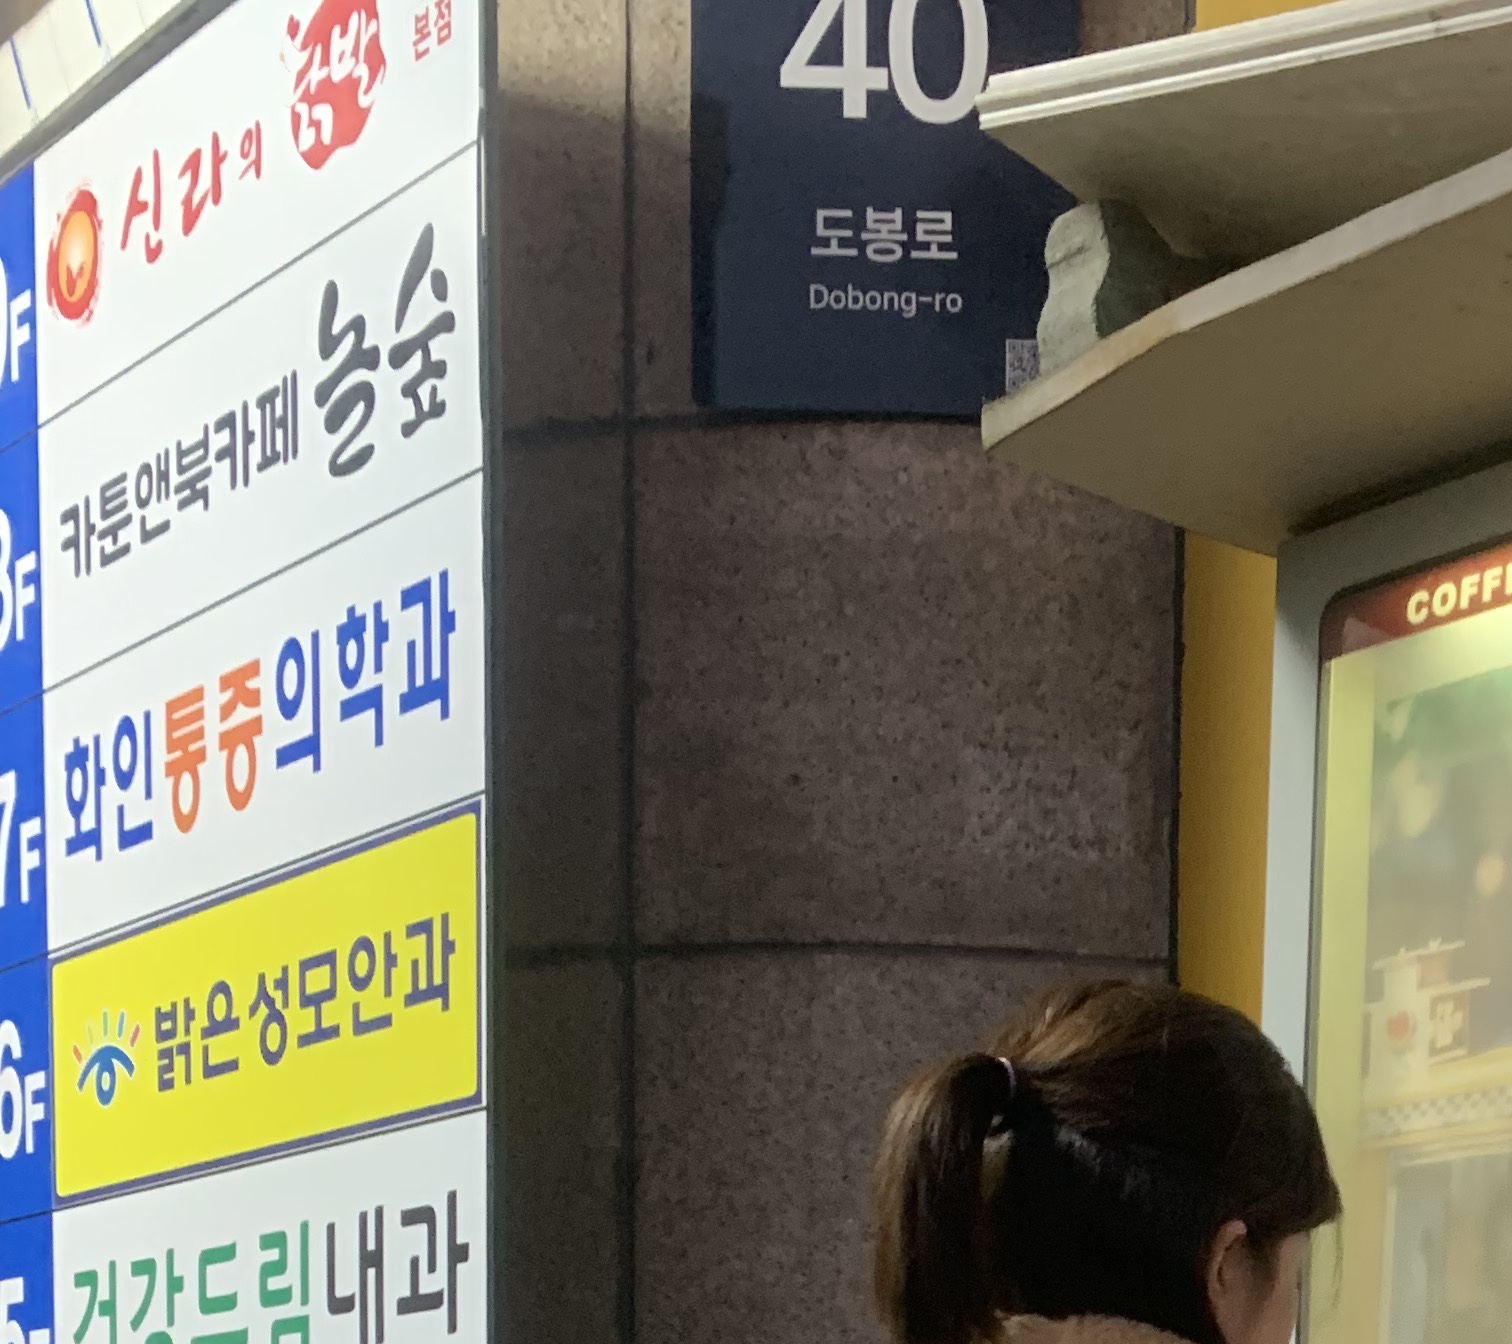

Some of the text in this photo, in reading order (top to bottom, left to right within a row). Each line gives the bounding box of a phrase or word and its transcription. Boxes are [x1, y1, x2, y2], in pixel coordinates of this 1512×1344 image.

[121, 120, 263, 264] 신라의
[412, 0, 452, 61] 본점
[780, 0, 989, 124] 40
[809, 283, 962, 318] Dobong-ro
[810, 206, 958, 263] 도봉로
[59, 222, 456, 578] 카툰앤북카페 놀숲
[64, 568, 456, 862] 화인통증의학과
[0, 769, 41, 908] 7F
[155, 911, 456, 1093] 밝은성모안과
[0, 1019, 45, 1161] 6F
